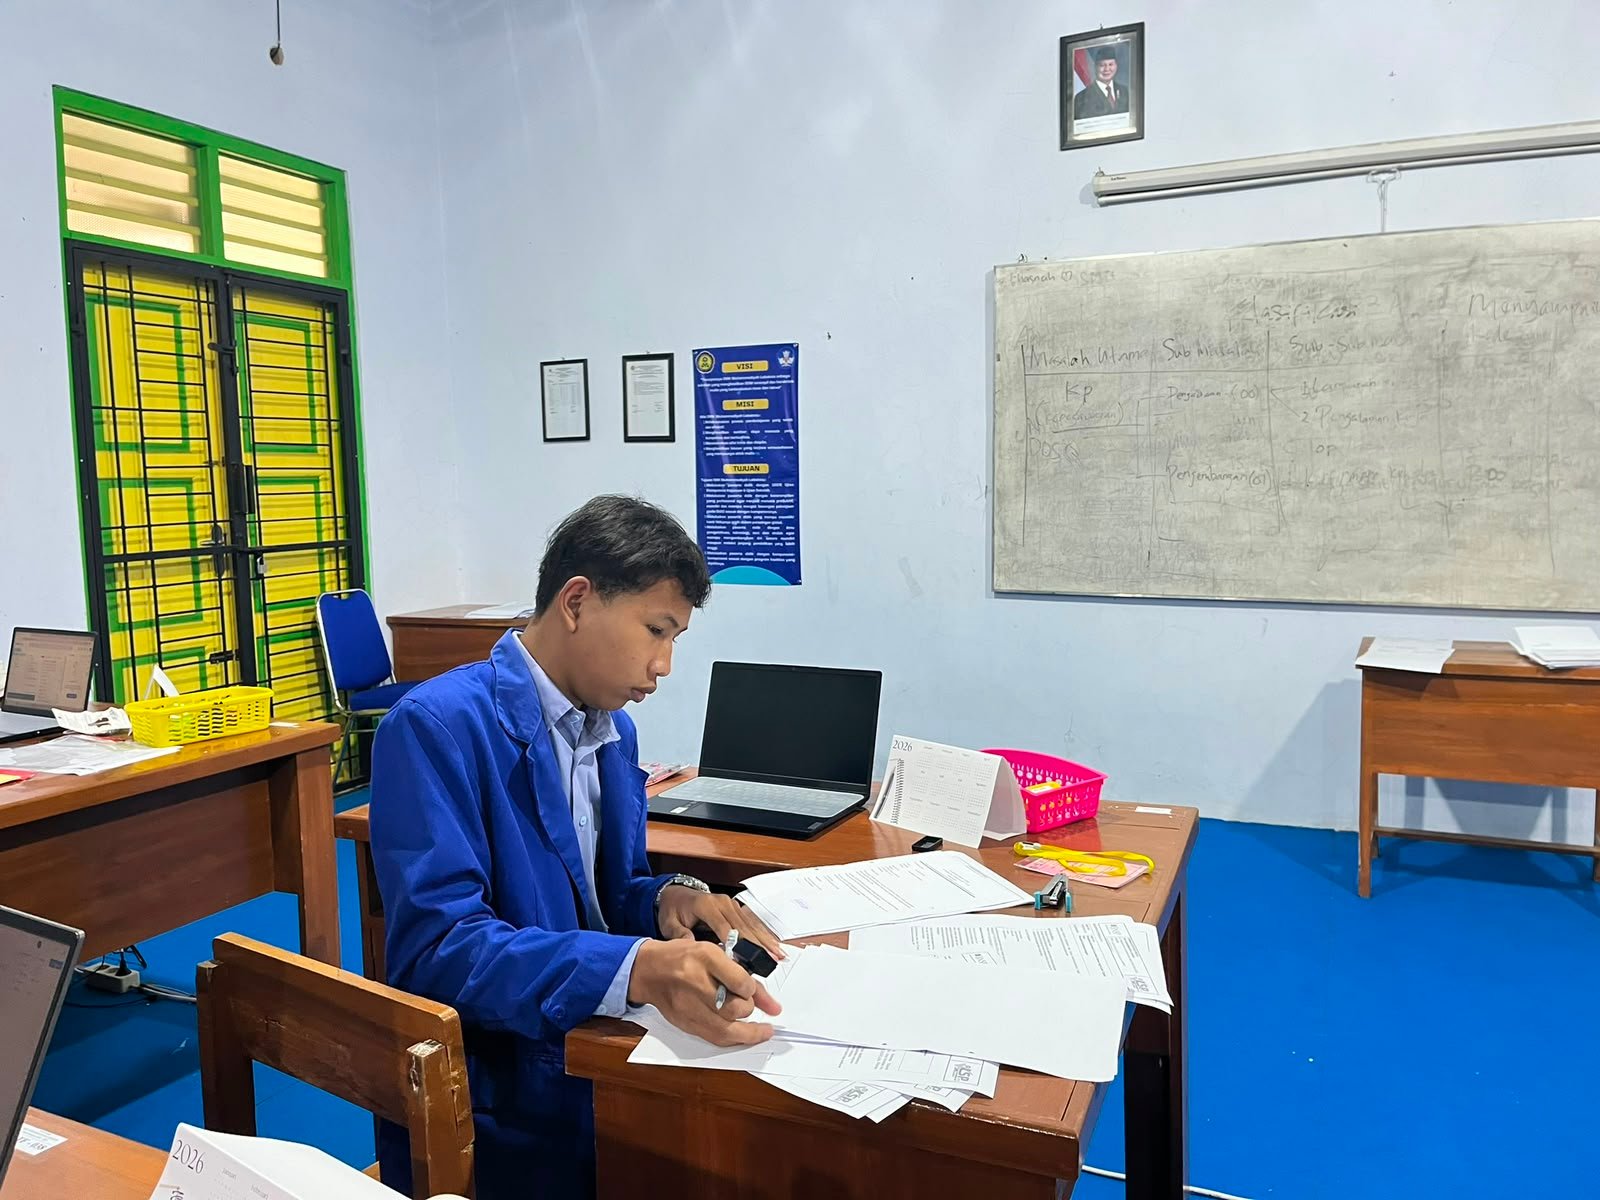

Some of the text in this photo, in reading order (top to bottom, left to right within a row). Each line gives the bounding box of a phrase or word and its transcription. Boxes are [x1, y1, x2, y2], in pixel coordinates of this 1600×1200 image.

[1162, 337, 1192, 362] Sub
[892, 739, 913, 752] 2026
[172, 1139, 206, 1174] 2026
